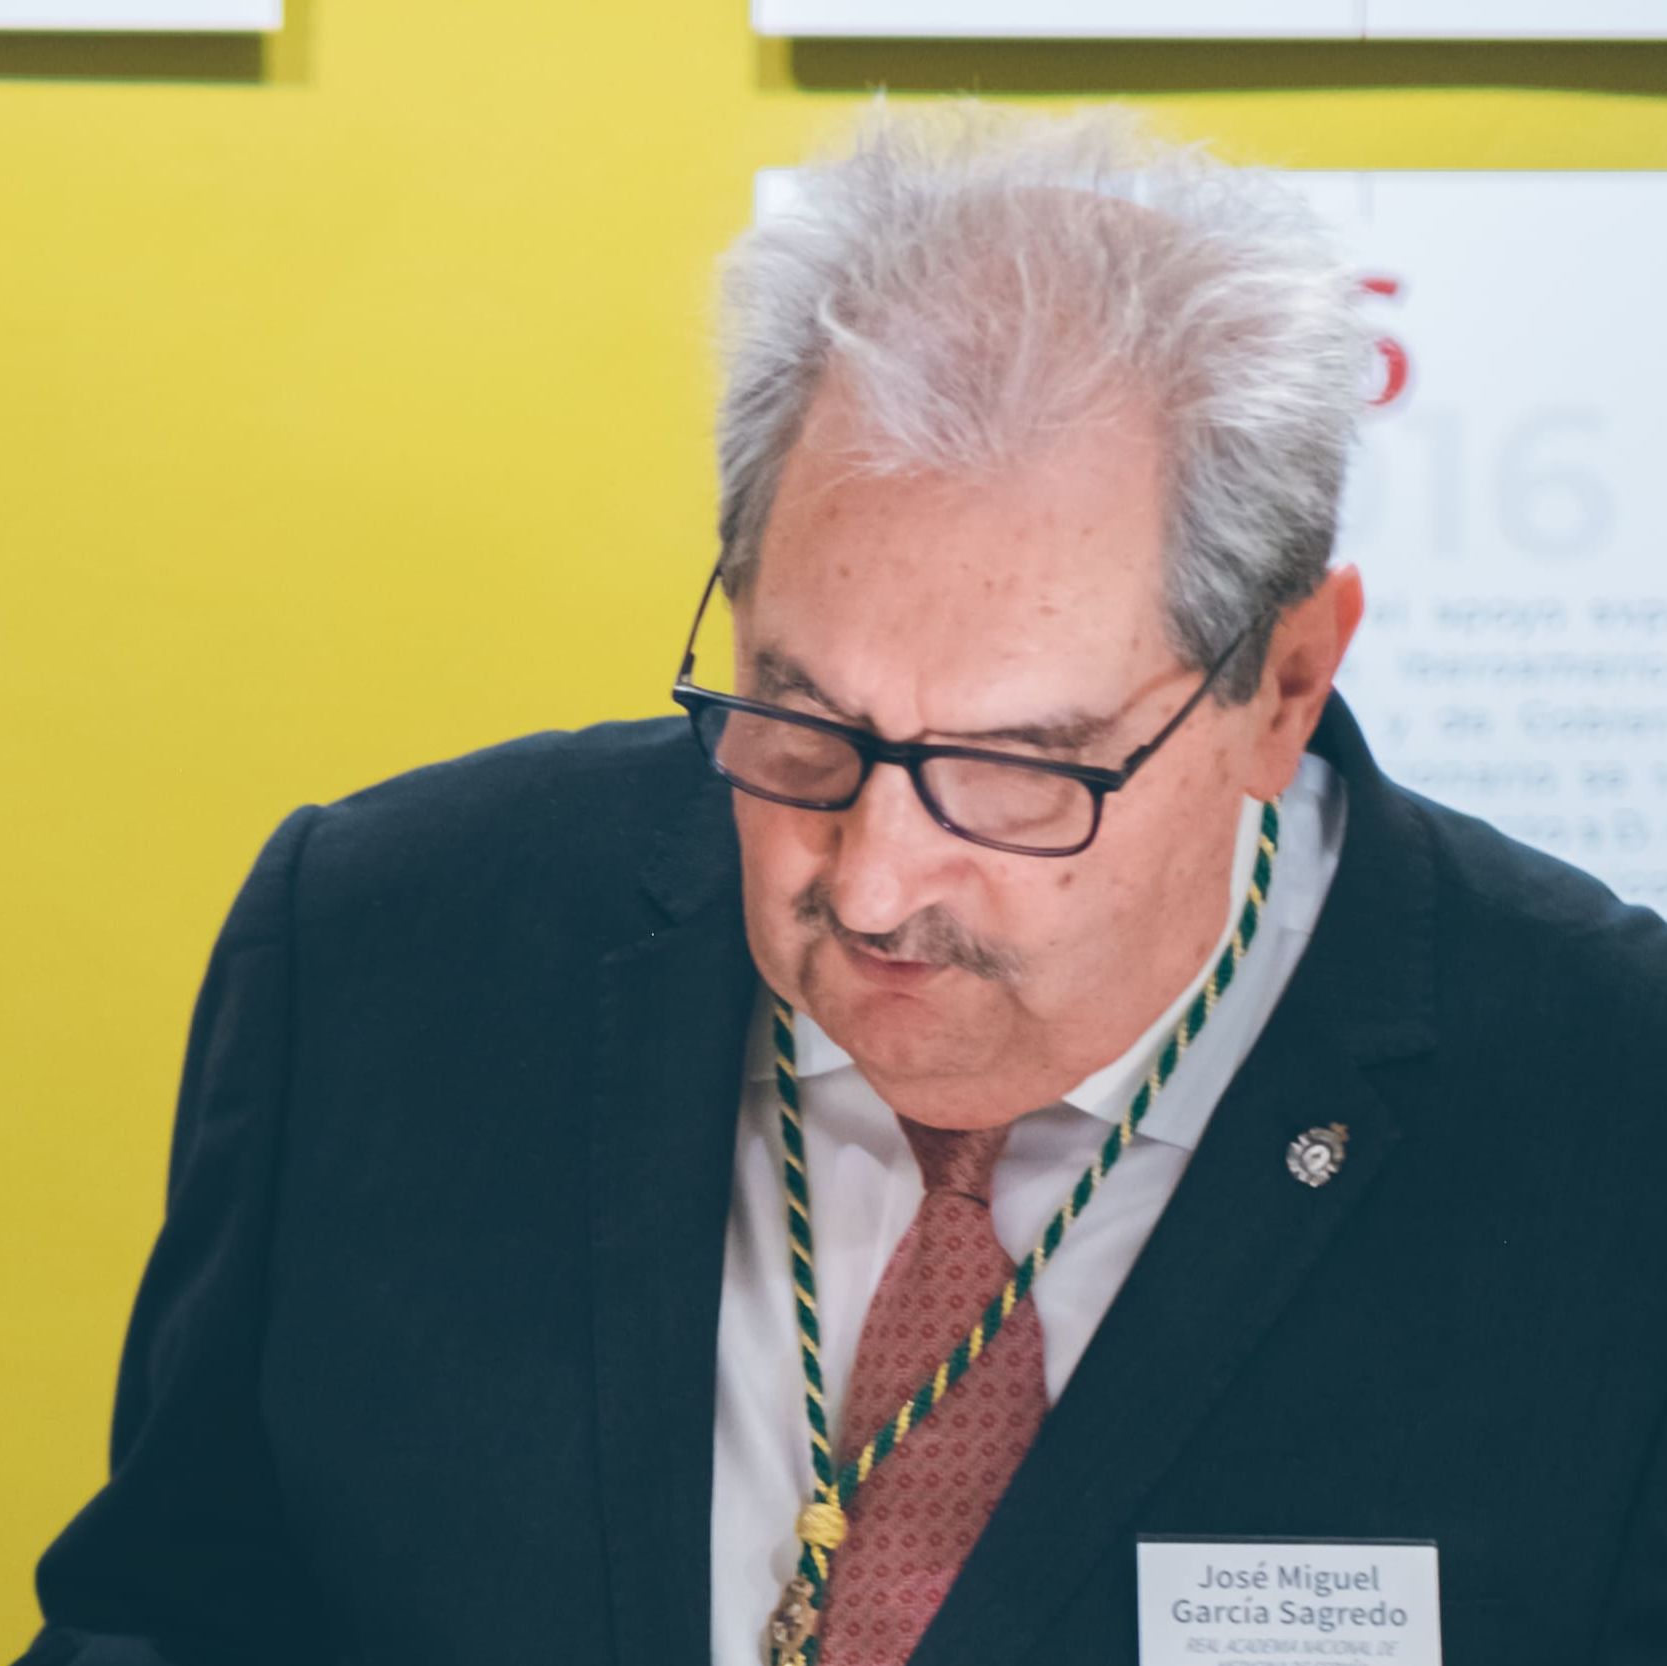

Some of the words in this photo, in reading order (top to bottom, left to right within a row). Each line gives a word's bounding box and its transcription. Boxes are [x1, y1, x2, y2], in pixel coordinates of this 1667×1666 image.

[1197, 1560, 1270, 1590] José
[1277, 1564, 1380, 1597] Miguel
[1171, 1596, 1271, 1625] García
[1279, 1600, 1409, 1633] Sagredo
